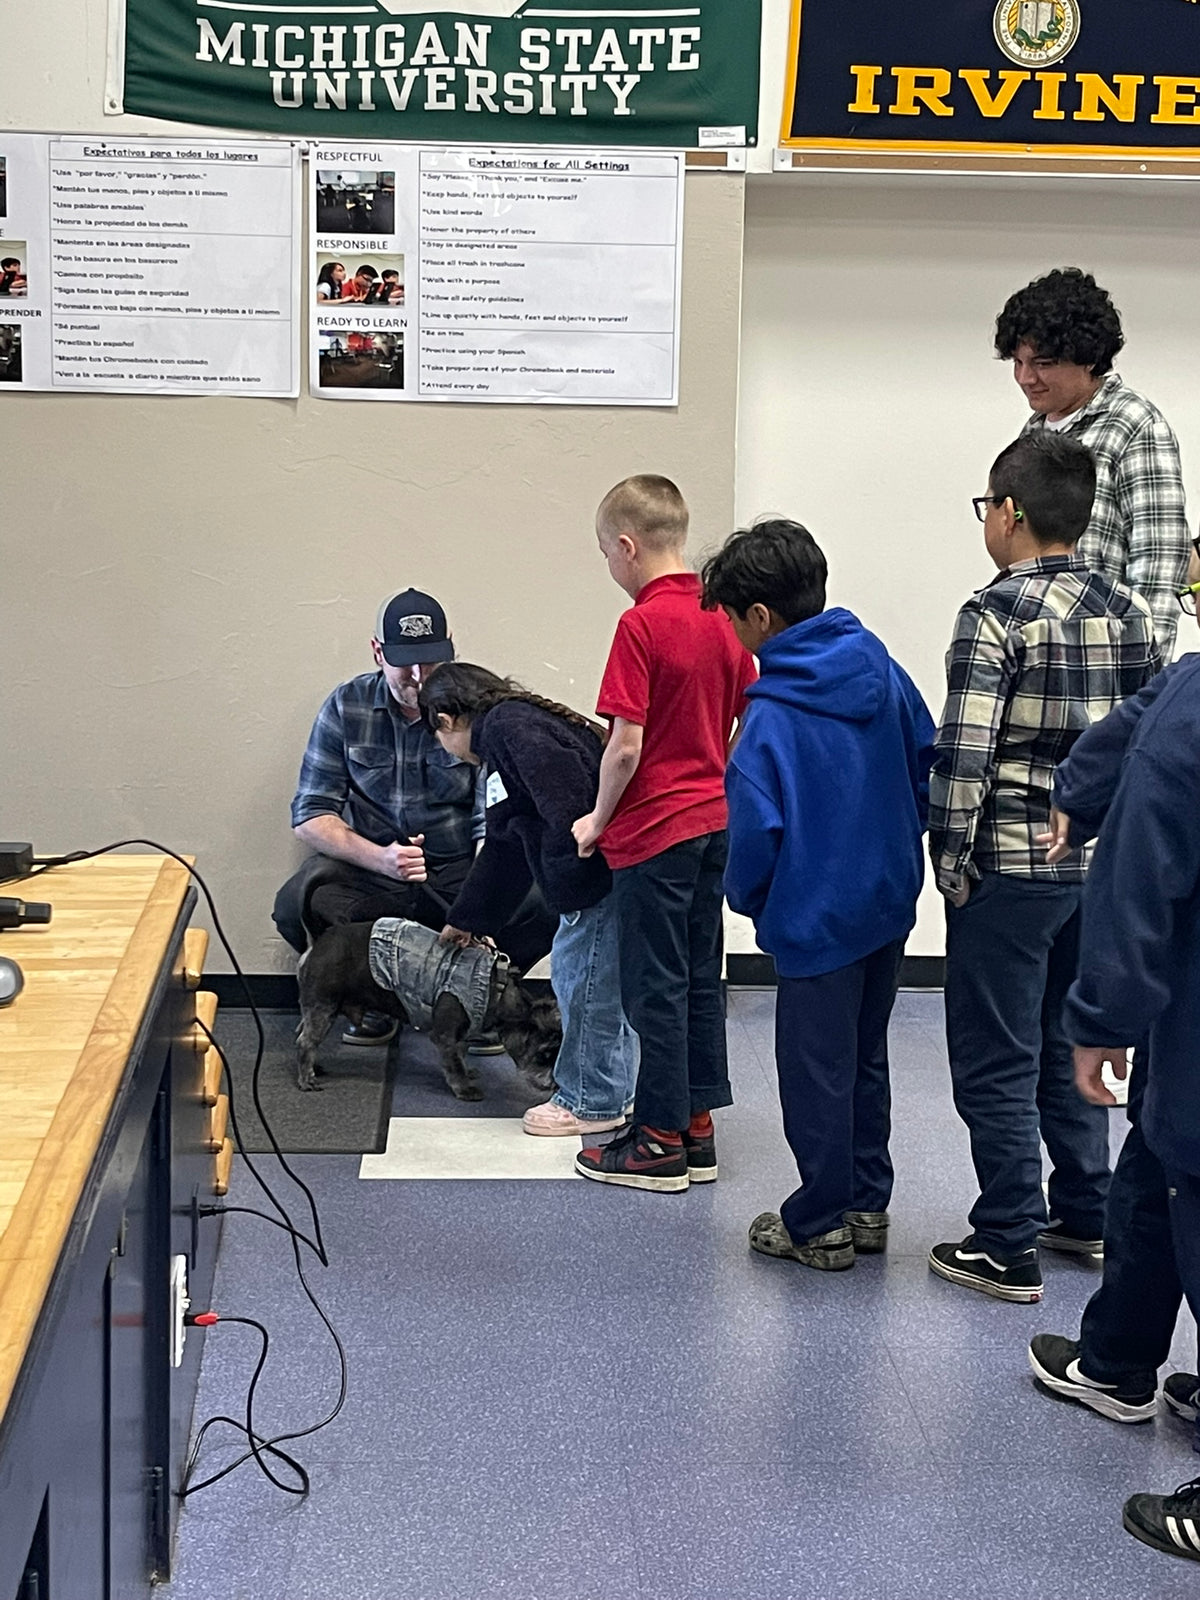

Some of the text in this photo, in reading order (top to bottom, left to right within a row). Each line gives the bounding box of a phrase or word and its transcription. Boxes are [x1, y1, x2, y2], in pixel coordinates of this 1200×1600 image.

[195, 18, 700, 71] MICHIGAN STATE
[270, 66, 640, 116] UNIVERSITY
[847, 65, 1200, 124] IRVINE
[83, 147, 258, 161] Expectativas para todos los lugares
[316, 151, 383, 162] RESPECTFUL
[468, 158, 630, 171] Expectations for All Settings
[506, 193, 535, 201] objects
[111, 203, 145, 211] amables
[94, 219, 135, 228] propiedad
[316, 239, 388, 250] RESPONSIBLE
[462, 295, 486, 303] safety
[317, 316, 407, 327] READY TO LEARN
[558, 315, 586, 323] objects
[103, 356, 159, 364] Chromebooks
[177, 358, 209, 366] cuidado
[519, 366, 565, 374] Chromebook
